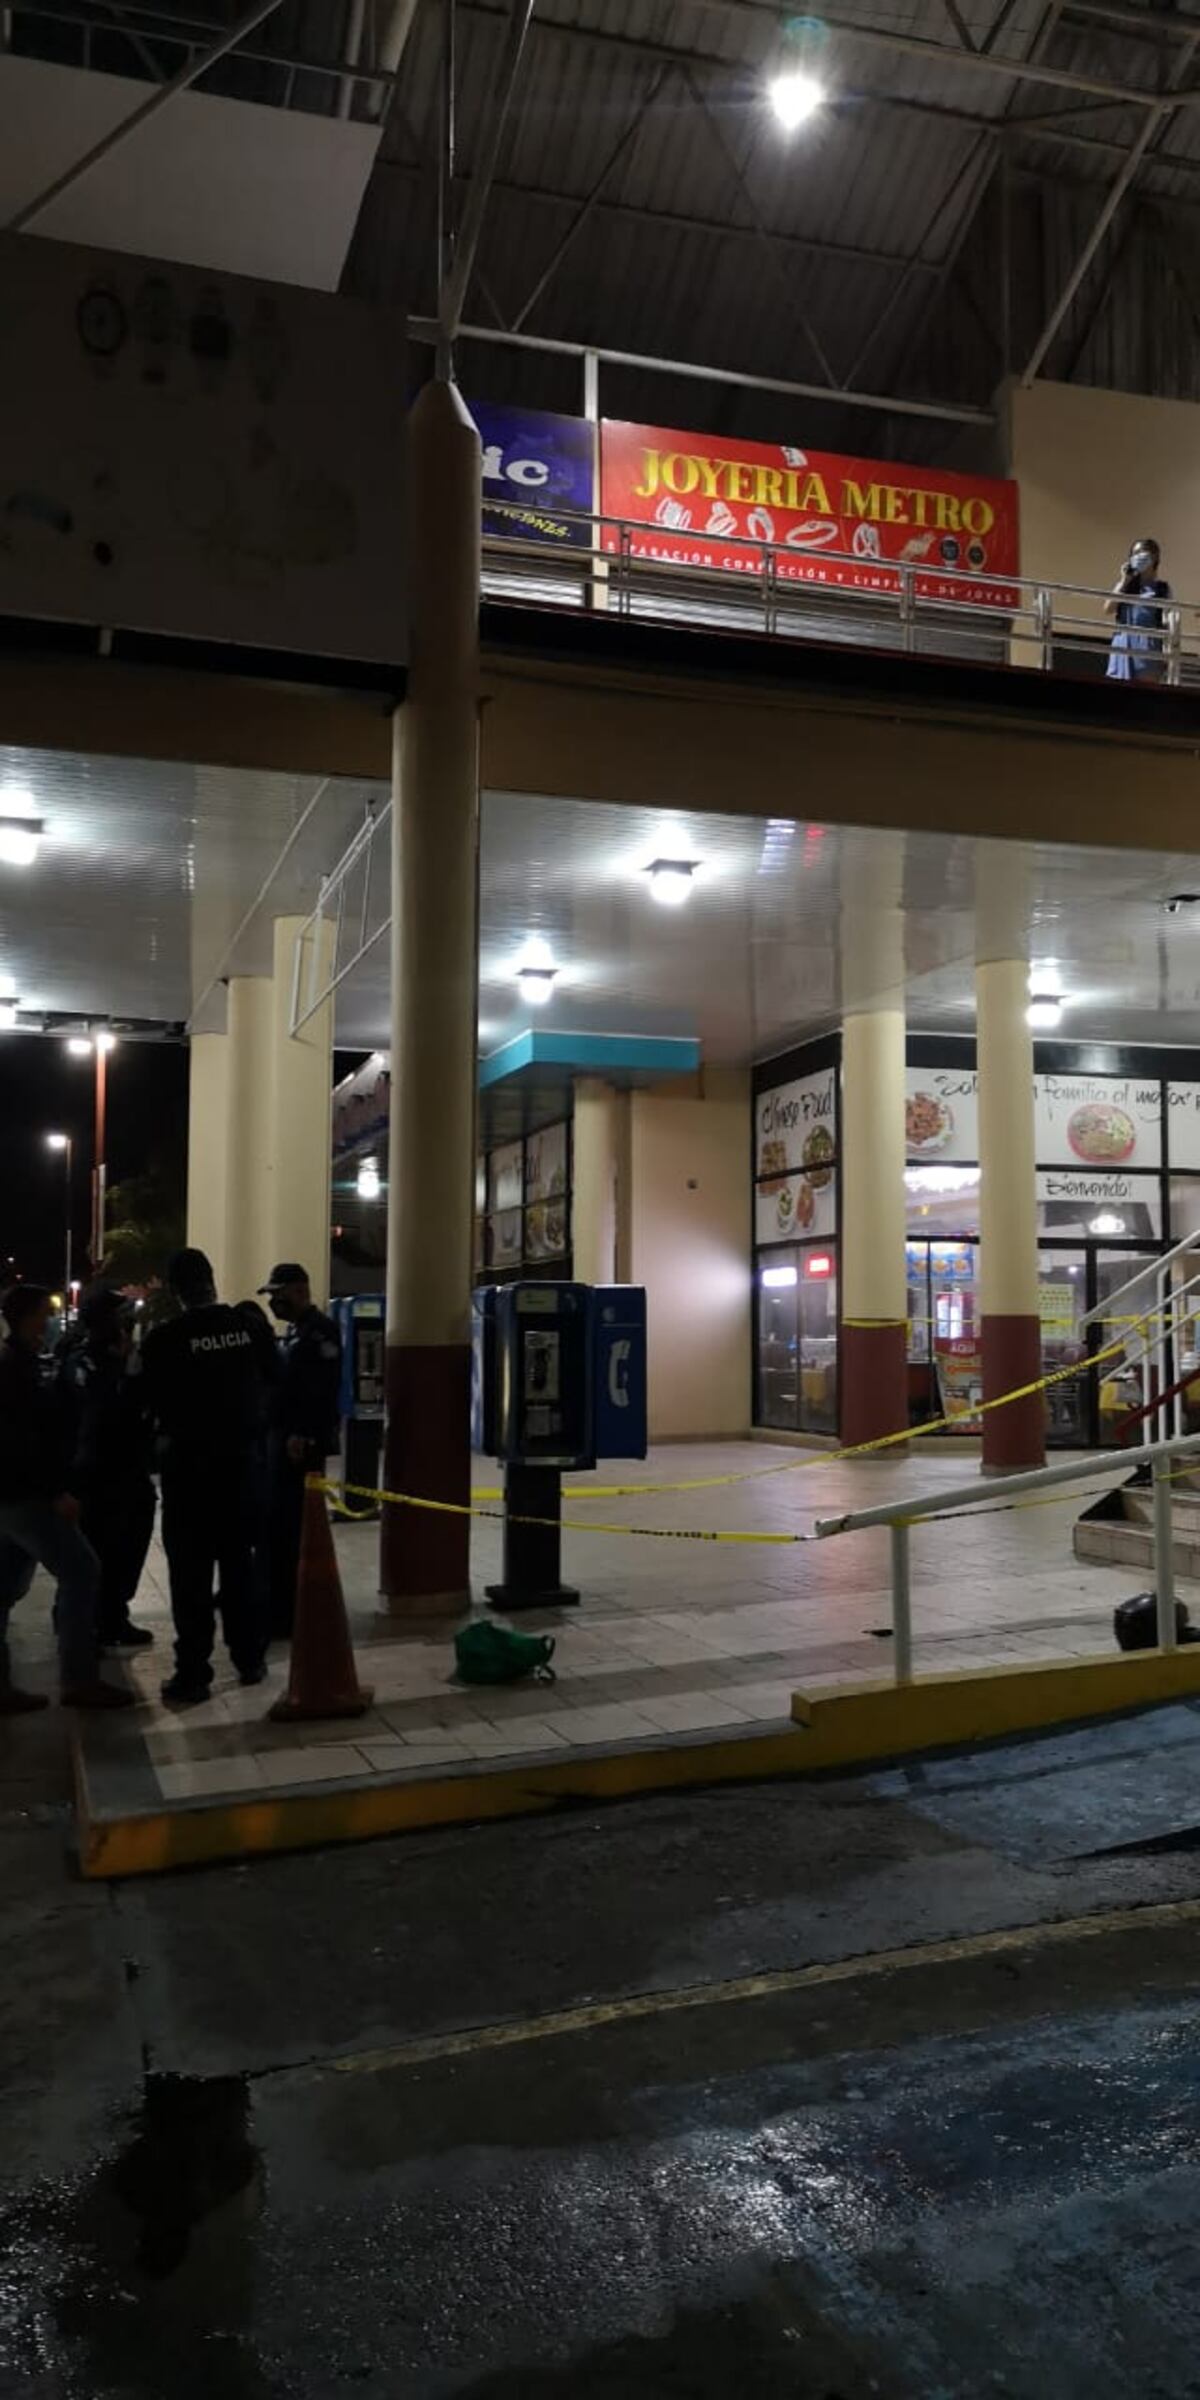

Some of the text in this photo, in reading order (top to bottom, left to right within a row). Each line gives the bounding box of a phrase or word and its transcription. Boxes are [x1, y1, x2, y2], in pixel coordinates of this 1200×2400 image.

[482, 446, 549, 486] ic
[841, 479, 994, 536] METRO
[723, 557, 826, 578] CONFCCIÓN
[190, 1331, 251, 1353] POLICIA
